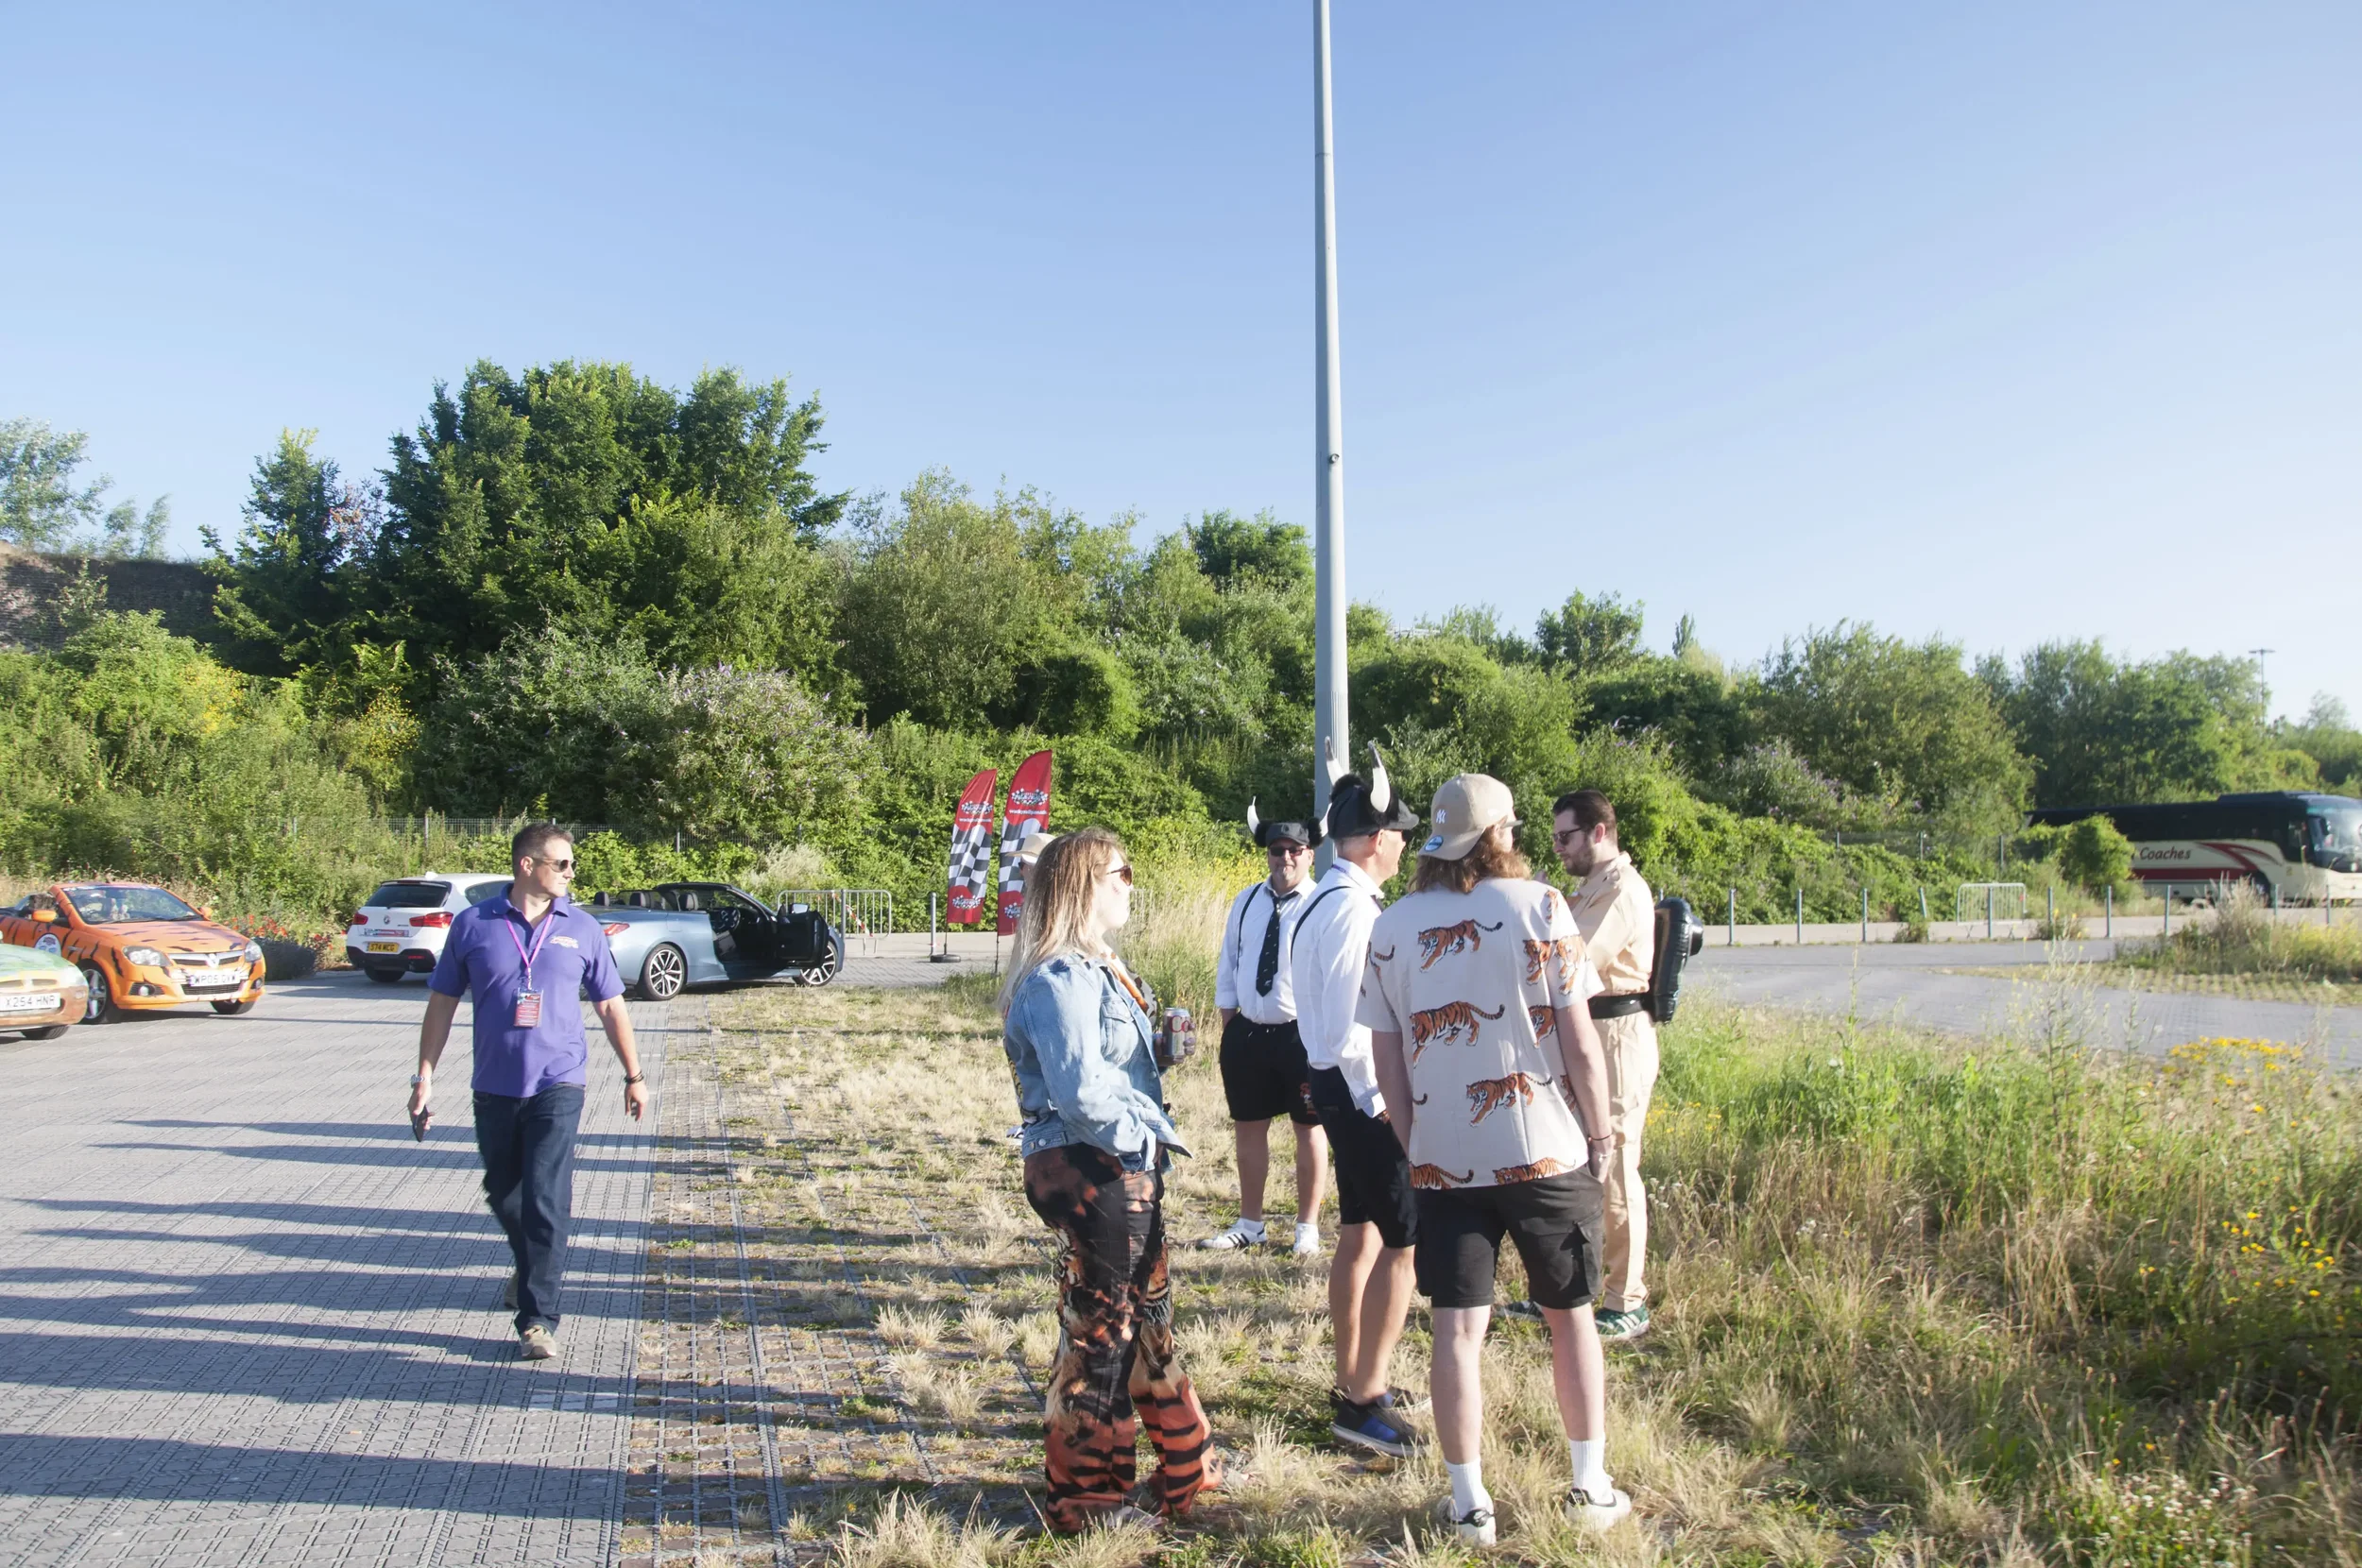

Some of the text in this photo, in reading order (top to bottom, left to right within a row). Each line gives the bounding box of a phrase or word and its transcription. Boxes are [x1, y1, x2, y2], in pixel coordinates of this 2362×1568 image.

[2139, 845, 2191, 861] Coaches
[5, 995, 56, 1008] X254 HNR
